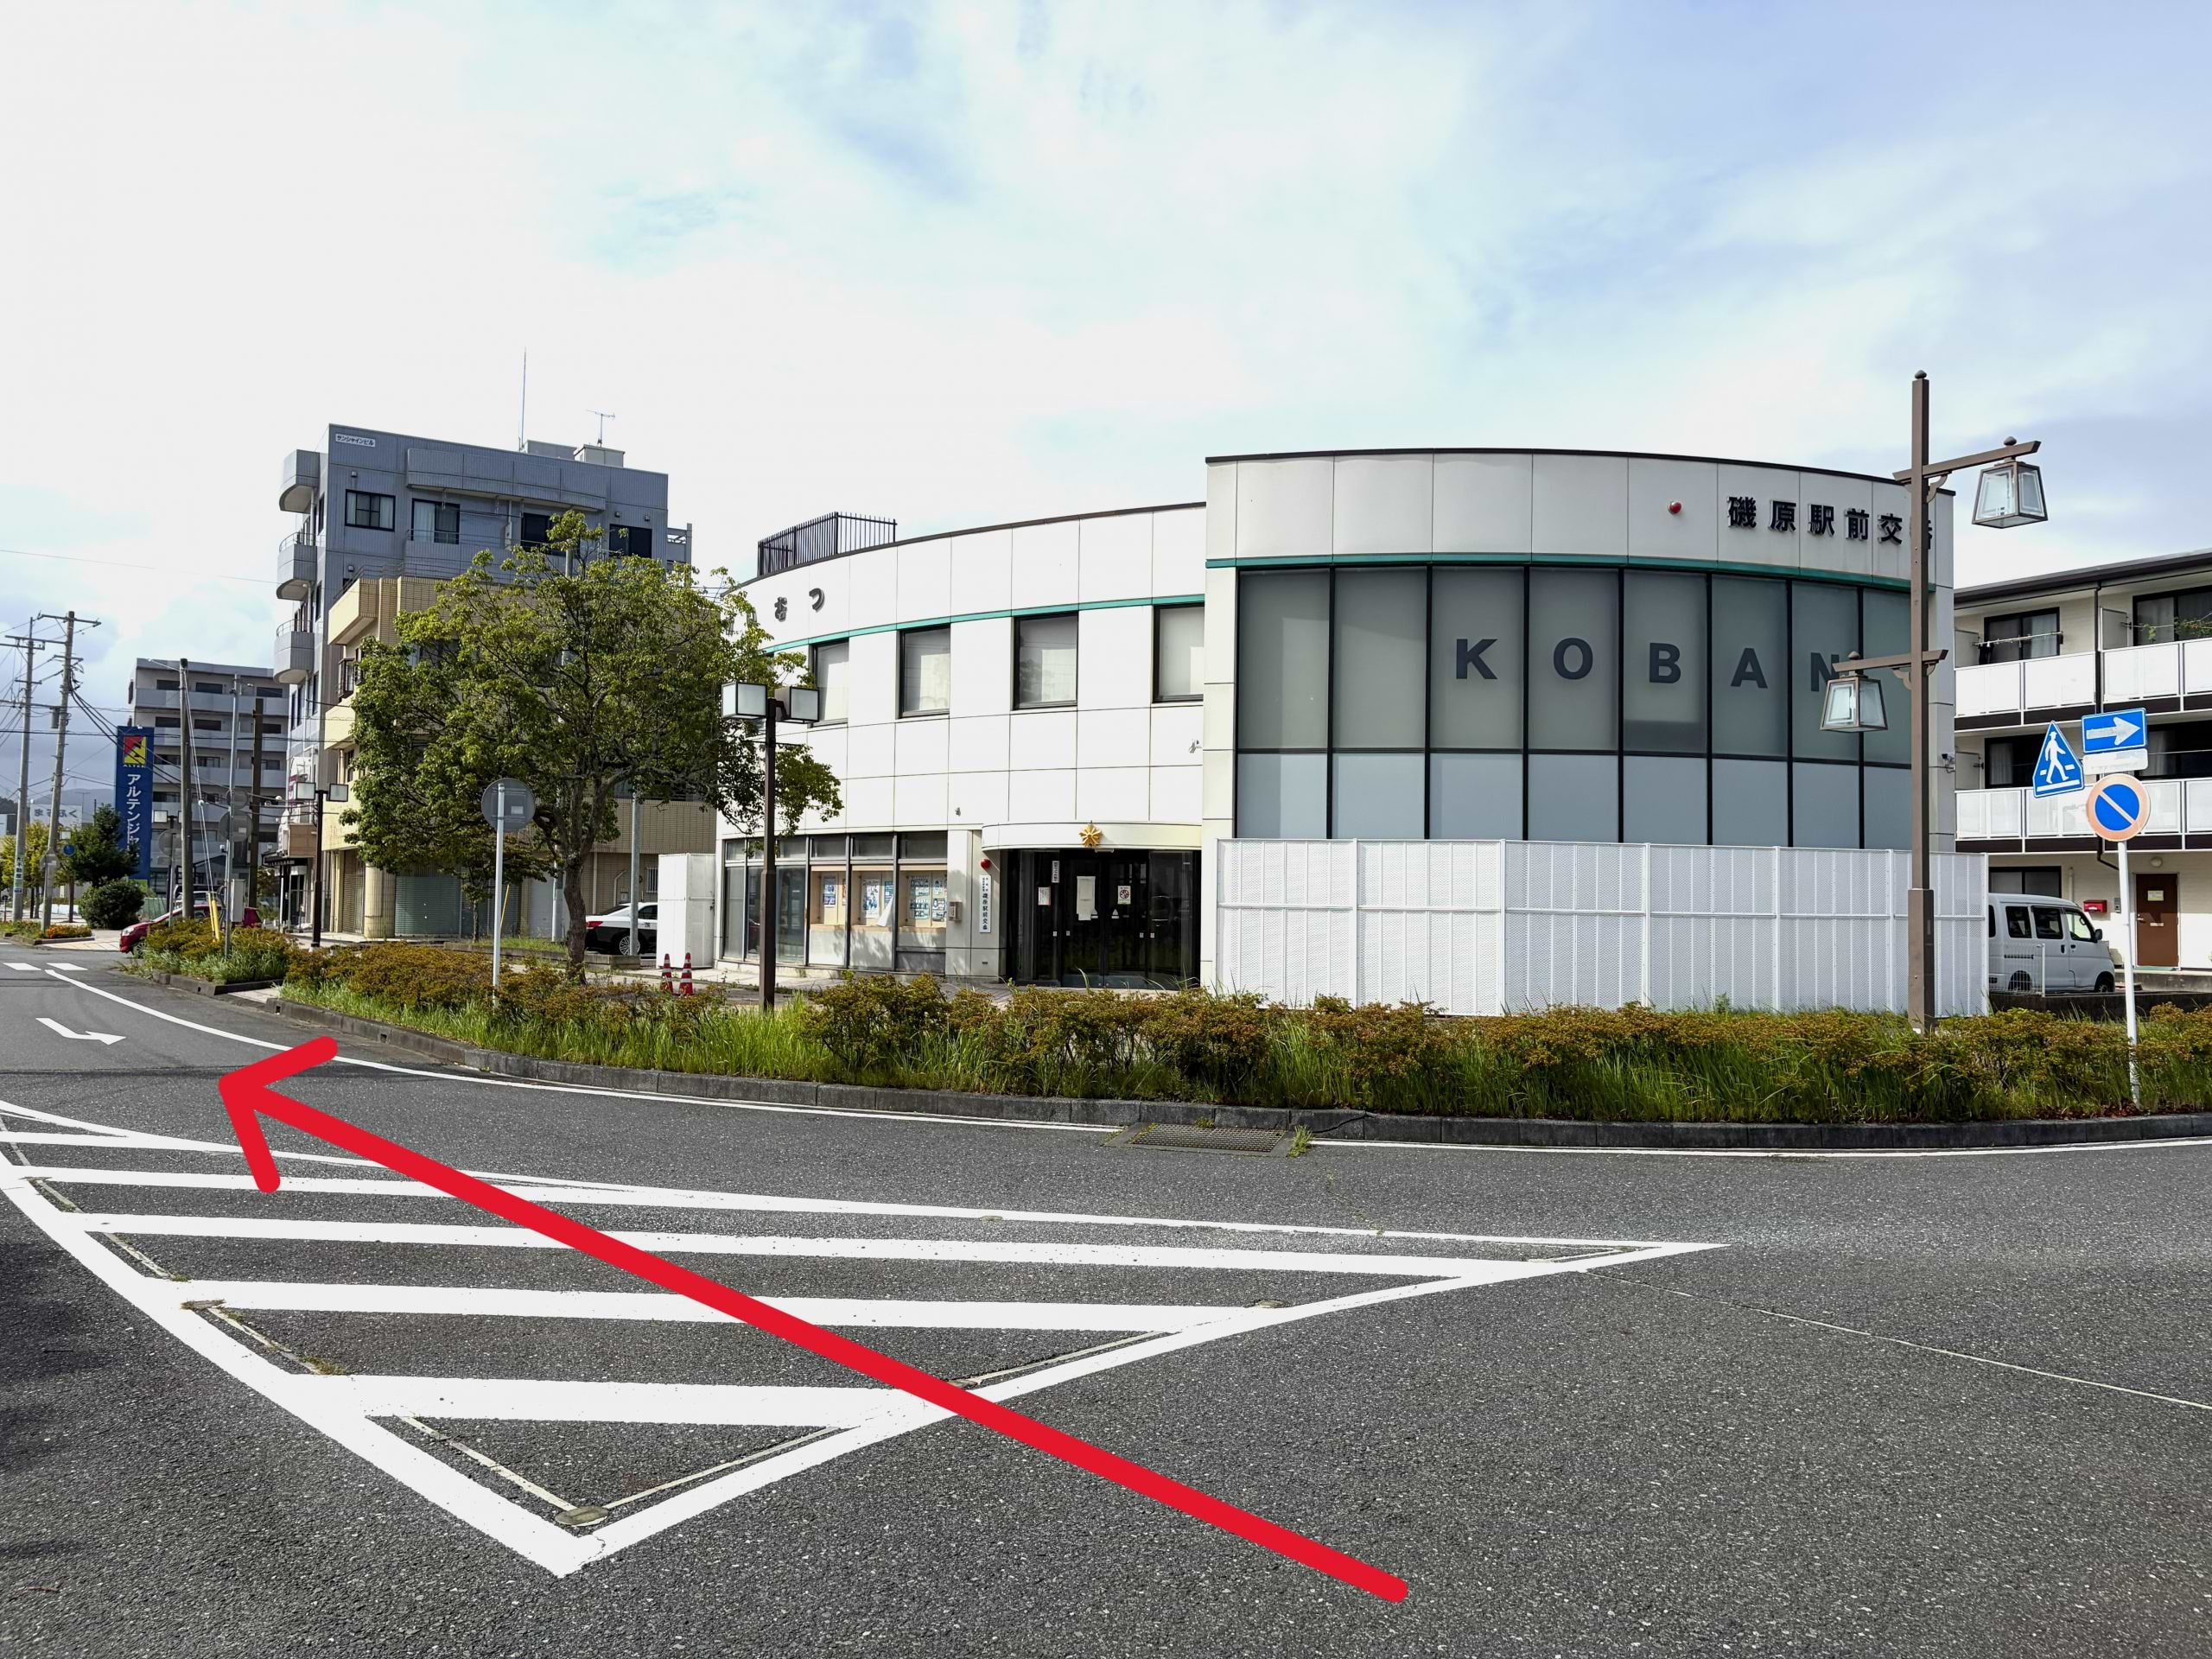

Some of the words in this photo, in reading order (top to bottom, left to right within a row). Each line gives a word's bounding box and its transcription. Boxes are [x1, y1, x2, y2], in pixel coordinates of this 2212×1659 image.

[1727, 496, 1933, 550] 磯原駅前交
[1456, 638, 1840, 692] KOBAN
